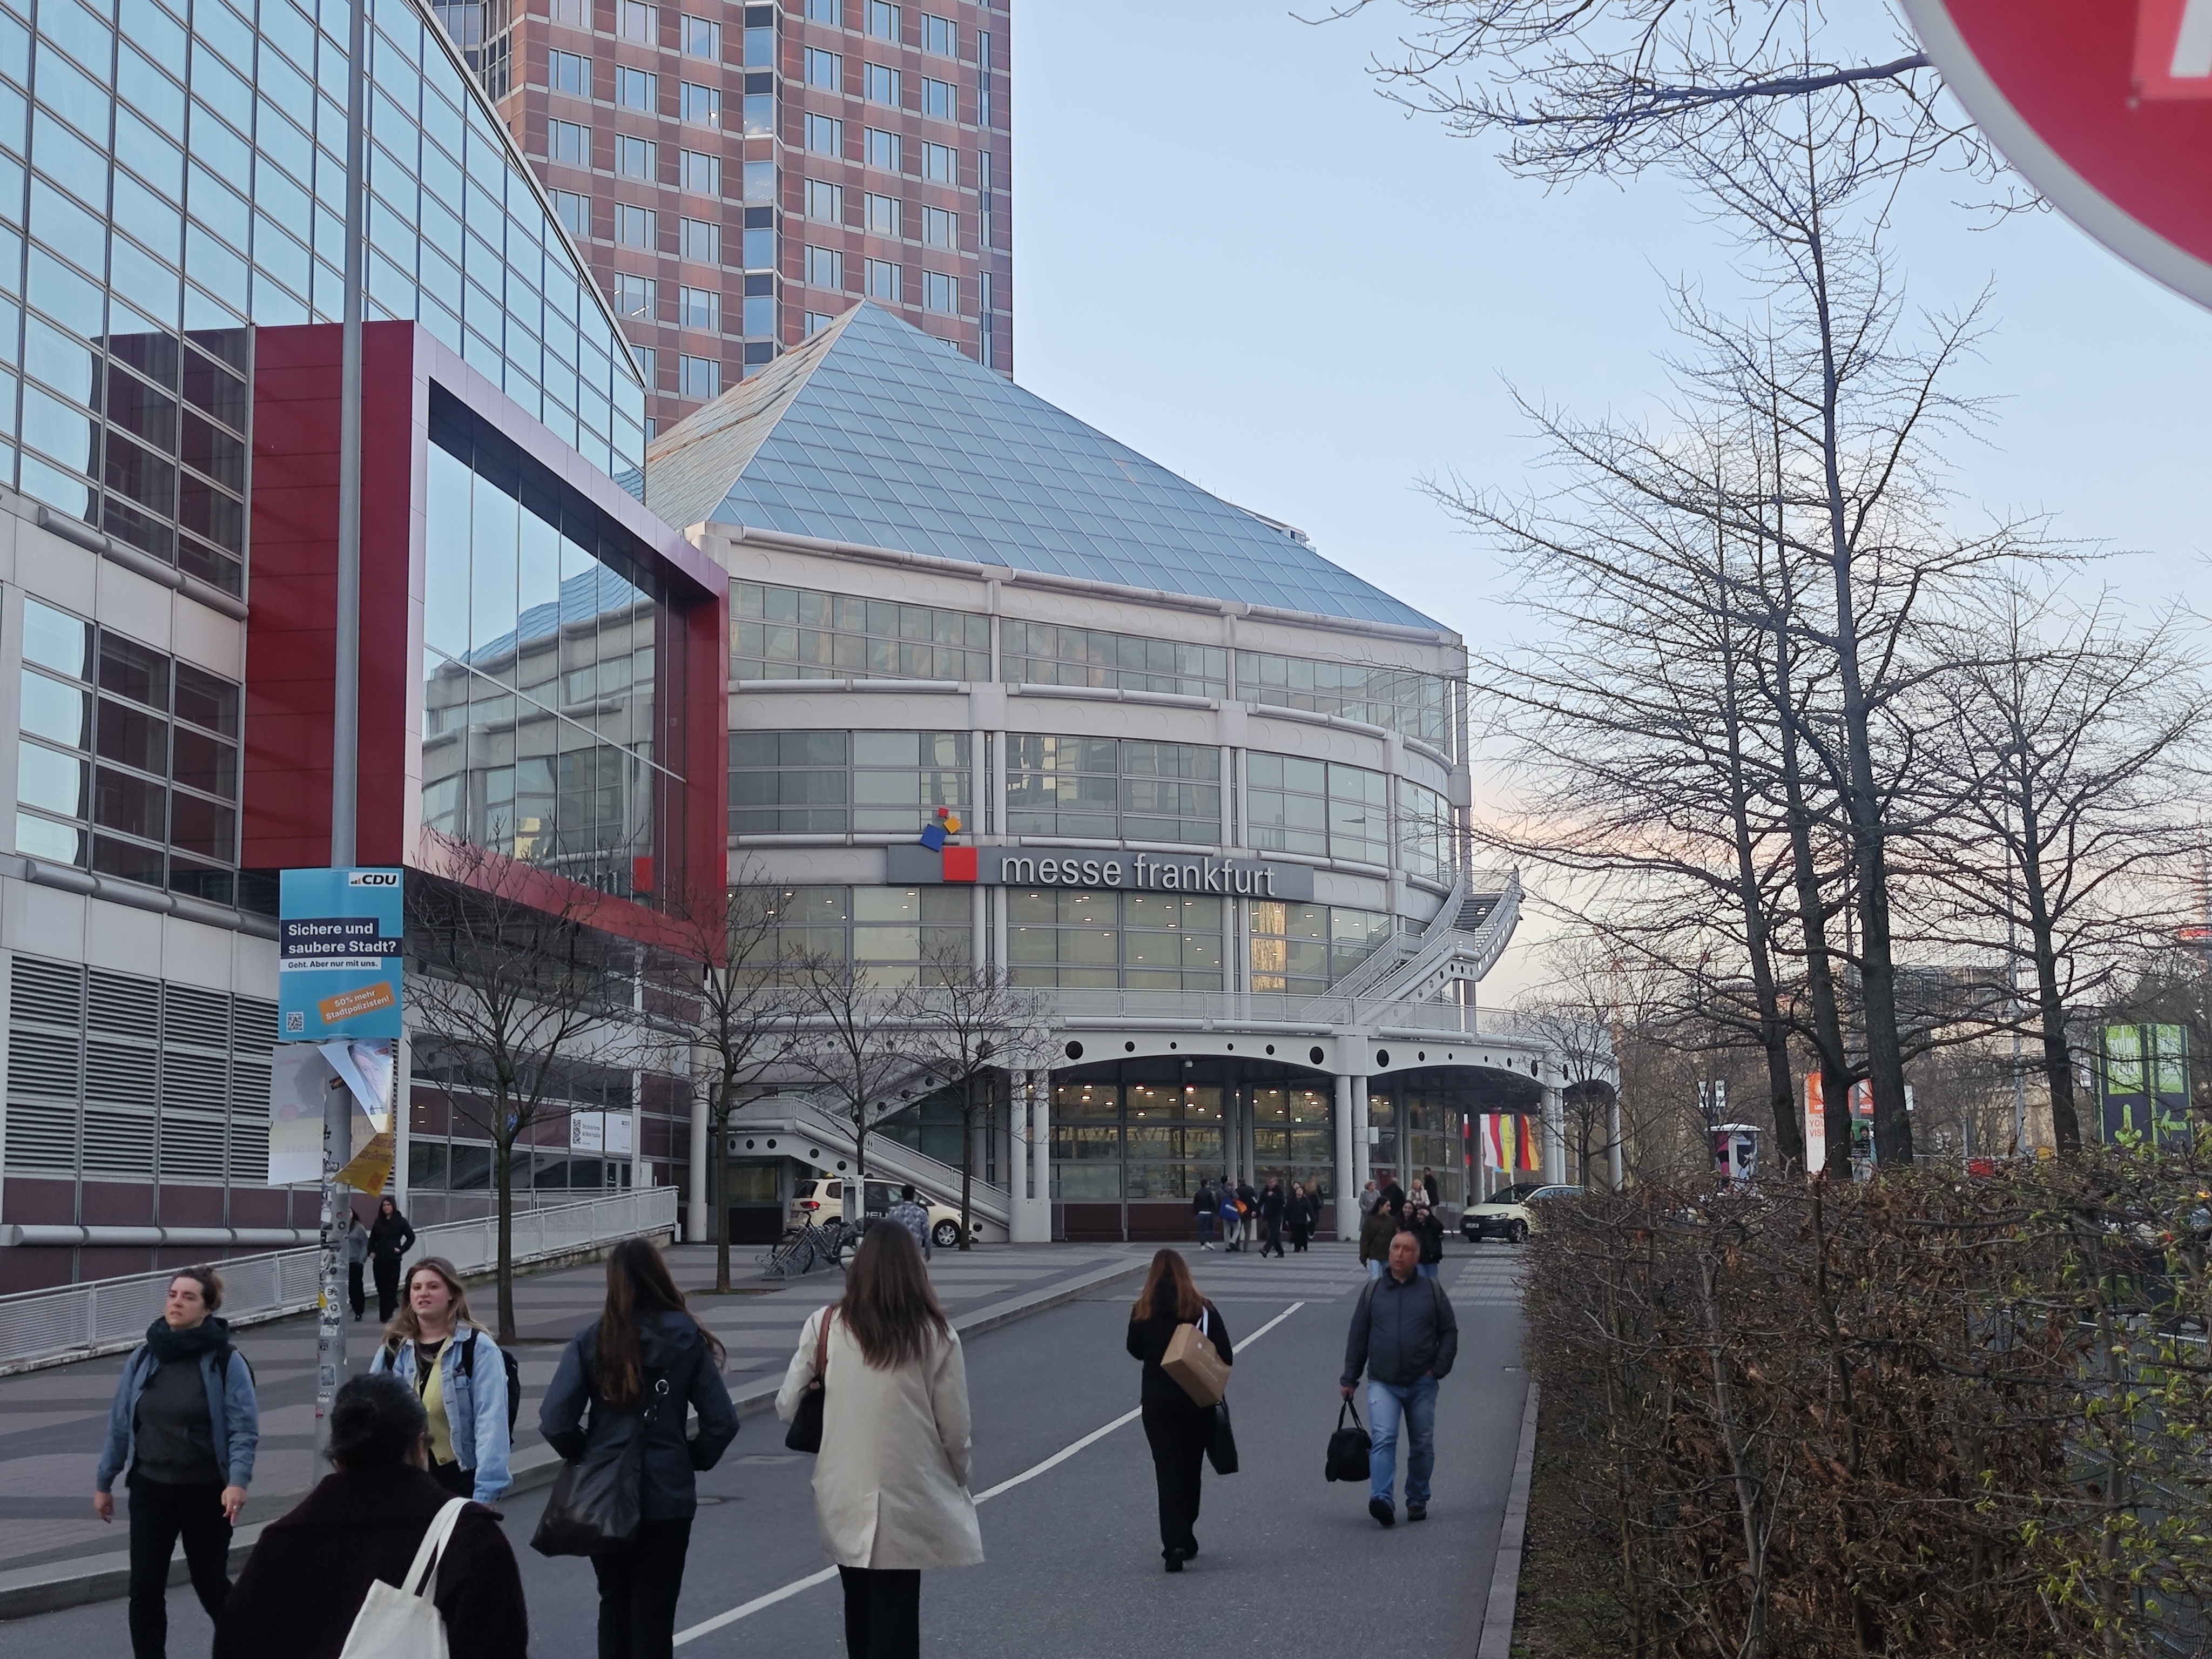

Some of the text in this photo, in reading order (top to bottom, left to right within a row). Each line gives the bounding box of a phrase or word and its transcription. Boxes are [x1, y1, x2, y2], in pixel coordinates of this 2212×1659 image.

[362, 874, 397, 885] CDU
[1001, 853, 1276, 895] messe frankfurt
[288, 922, 373, 936] Sichere und
[288, 940, 396, 954] saubere Stadt?
[334, 990, 376, 1007] 50% mehr
[326, 995, 390, 1020] Stadtpolizisten!
